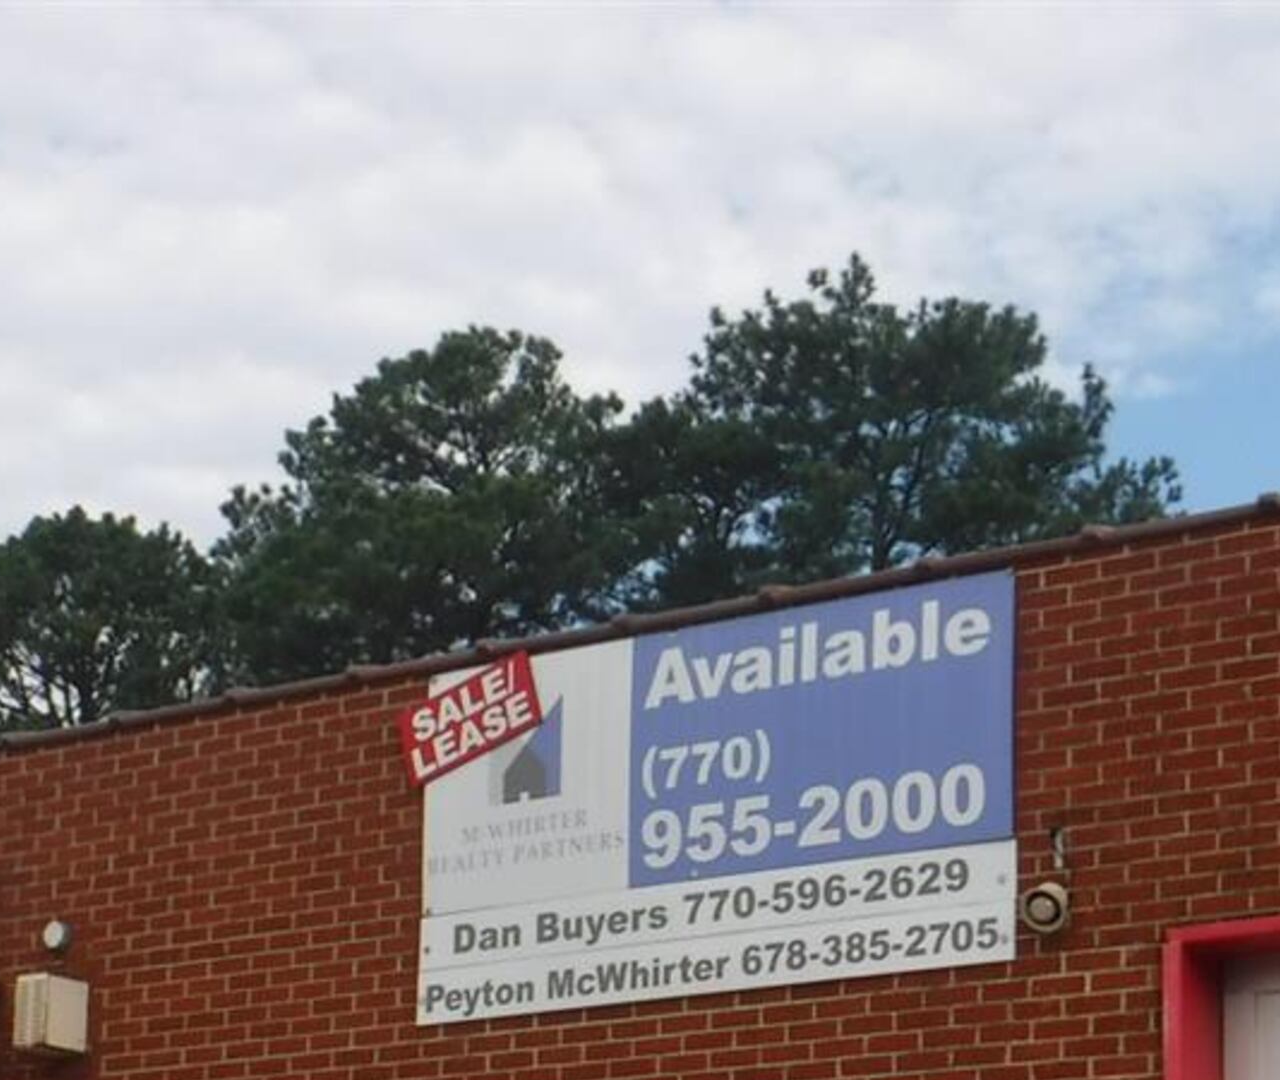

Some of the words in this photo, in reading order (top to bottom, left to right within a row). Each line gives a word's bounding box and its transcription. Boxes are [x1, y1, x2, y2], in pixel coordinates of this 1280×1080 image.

[411, 659, 515, 743] SALE/
[644, 599, 992, 711] Available
[410, 690, 533, 780] LEASE
[641, 729, 771, 800] (770)
[512, 832, 625, 866] PARTNERS
[641, 763, 986, 869] 955-2000
[453, 922, 522, 955] Dan
[535, 904, 668, 946] Buyers
[682, 857, 970, 926] 770-596-2629
[424, 978, 535, 1017] Peyton
[546, 953, 732, 1001] McWhirter
[741, 917, 1001, 977] 678-385-2705
